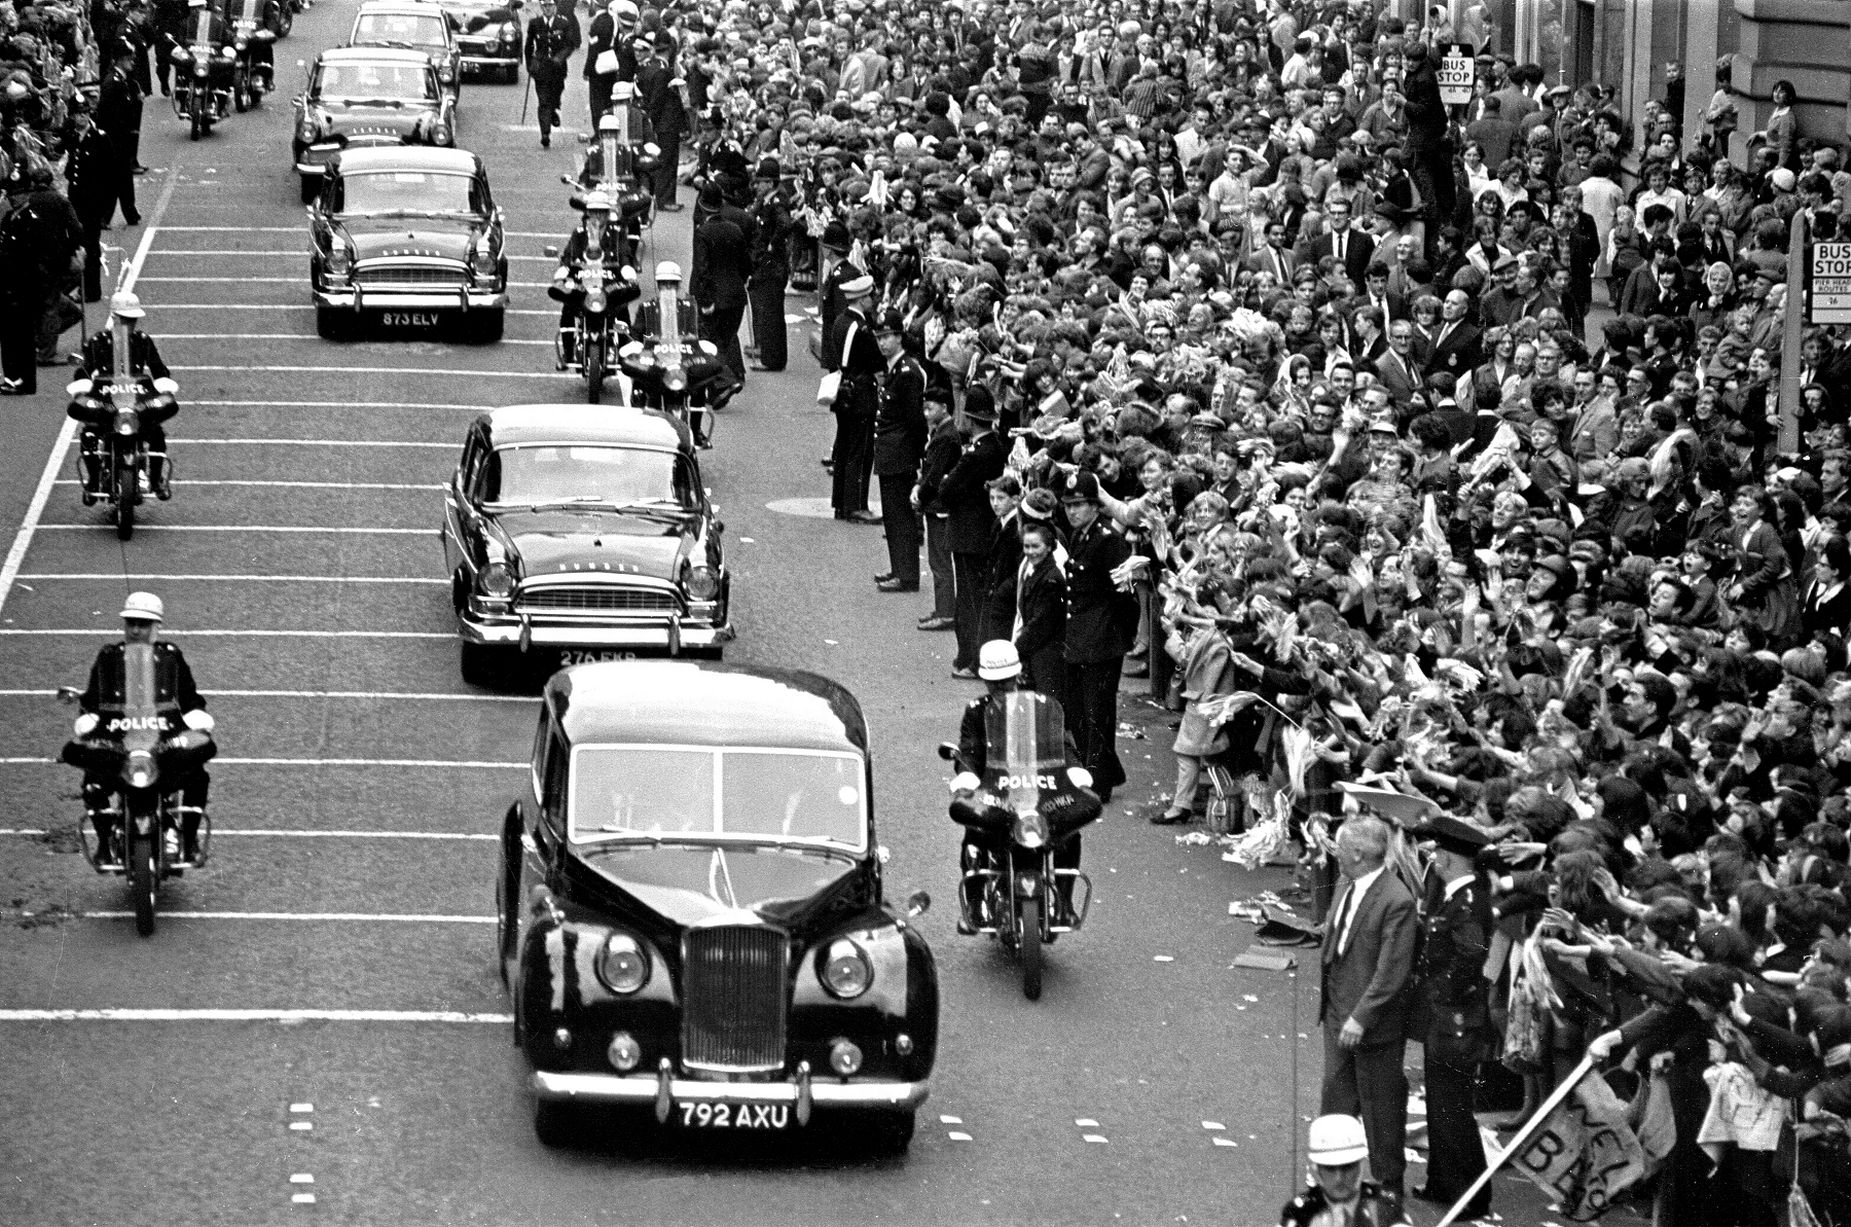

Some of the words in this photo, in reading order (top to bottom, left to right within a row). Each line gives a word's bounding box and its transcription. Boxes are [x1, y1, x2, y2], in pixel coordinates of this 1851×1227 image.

[1443, 60, 1466, 71] BUS
[1438, 71, 1470, 83] STOP
[1820, 245, 1851, 259] BUS
[577, 268, 615, 280] POLICE
[383, 312, 410, 326] 873
[412, 313, 439, 326] ELV
[653, 343, 693, 355] POLICE
[101, 384, 146, 395] POLICE
[560, 650, 596, 666] 276
[109, 716, 169, 733] POLICE
[998, 773, 1058, 790] POLICE
[679, 1102, 731, 1126] 792
[735, 1104, 788, 1128] AXU
